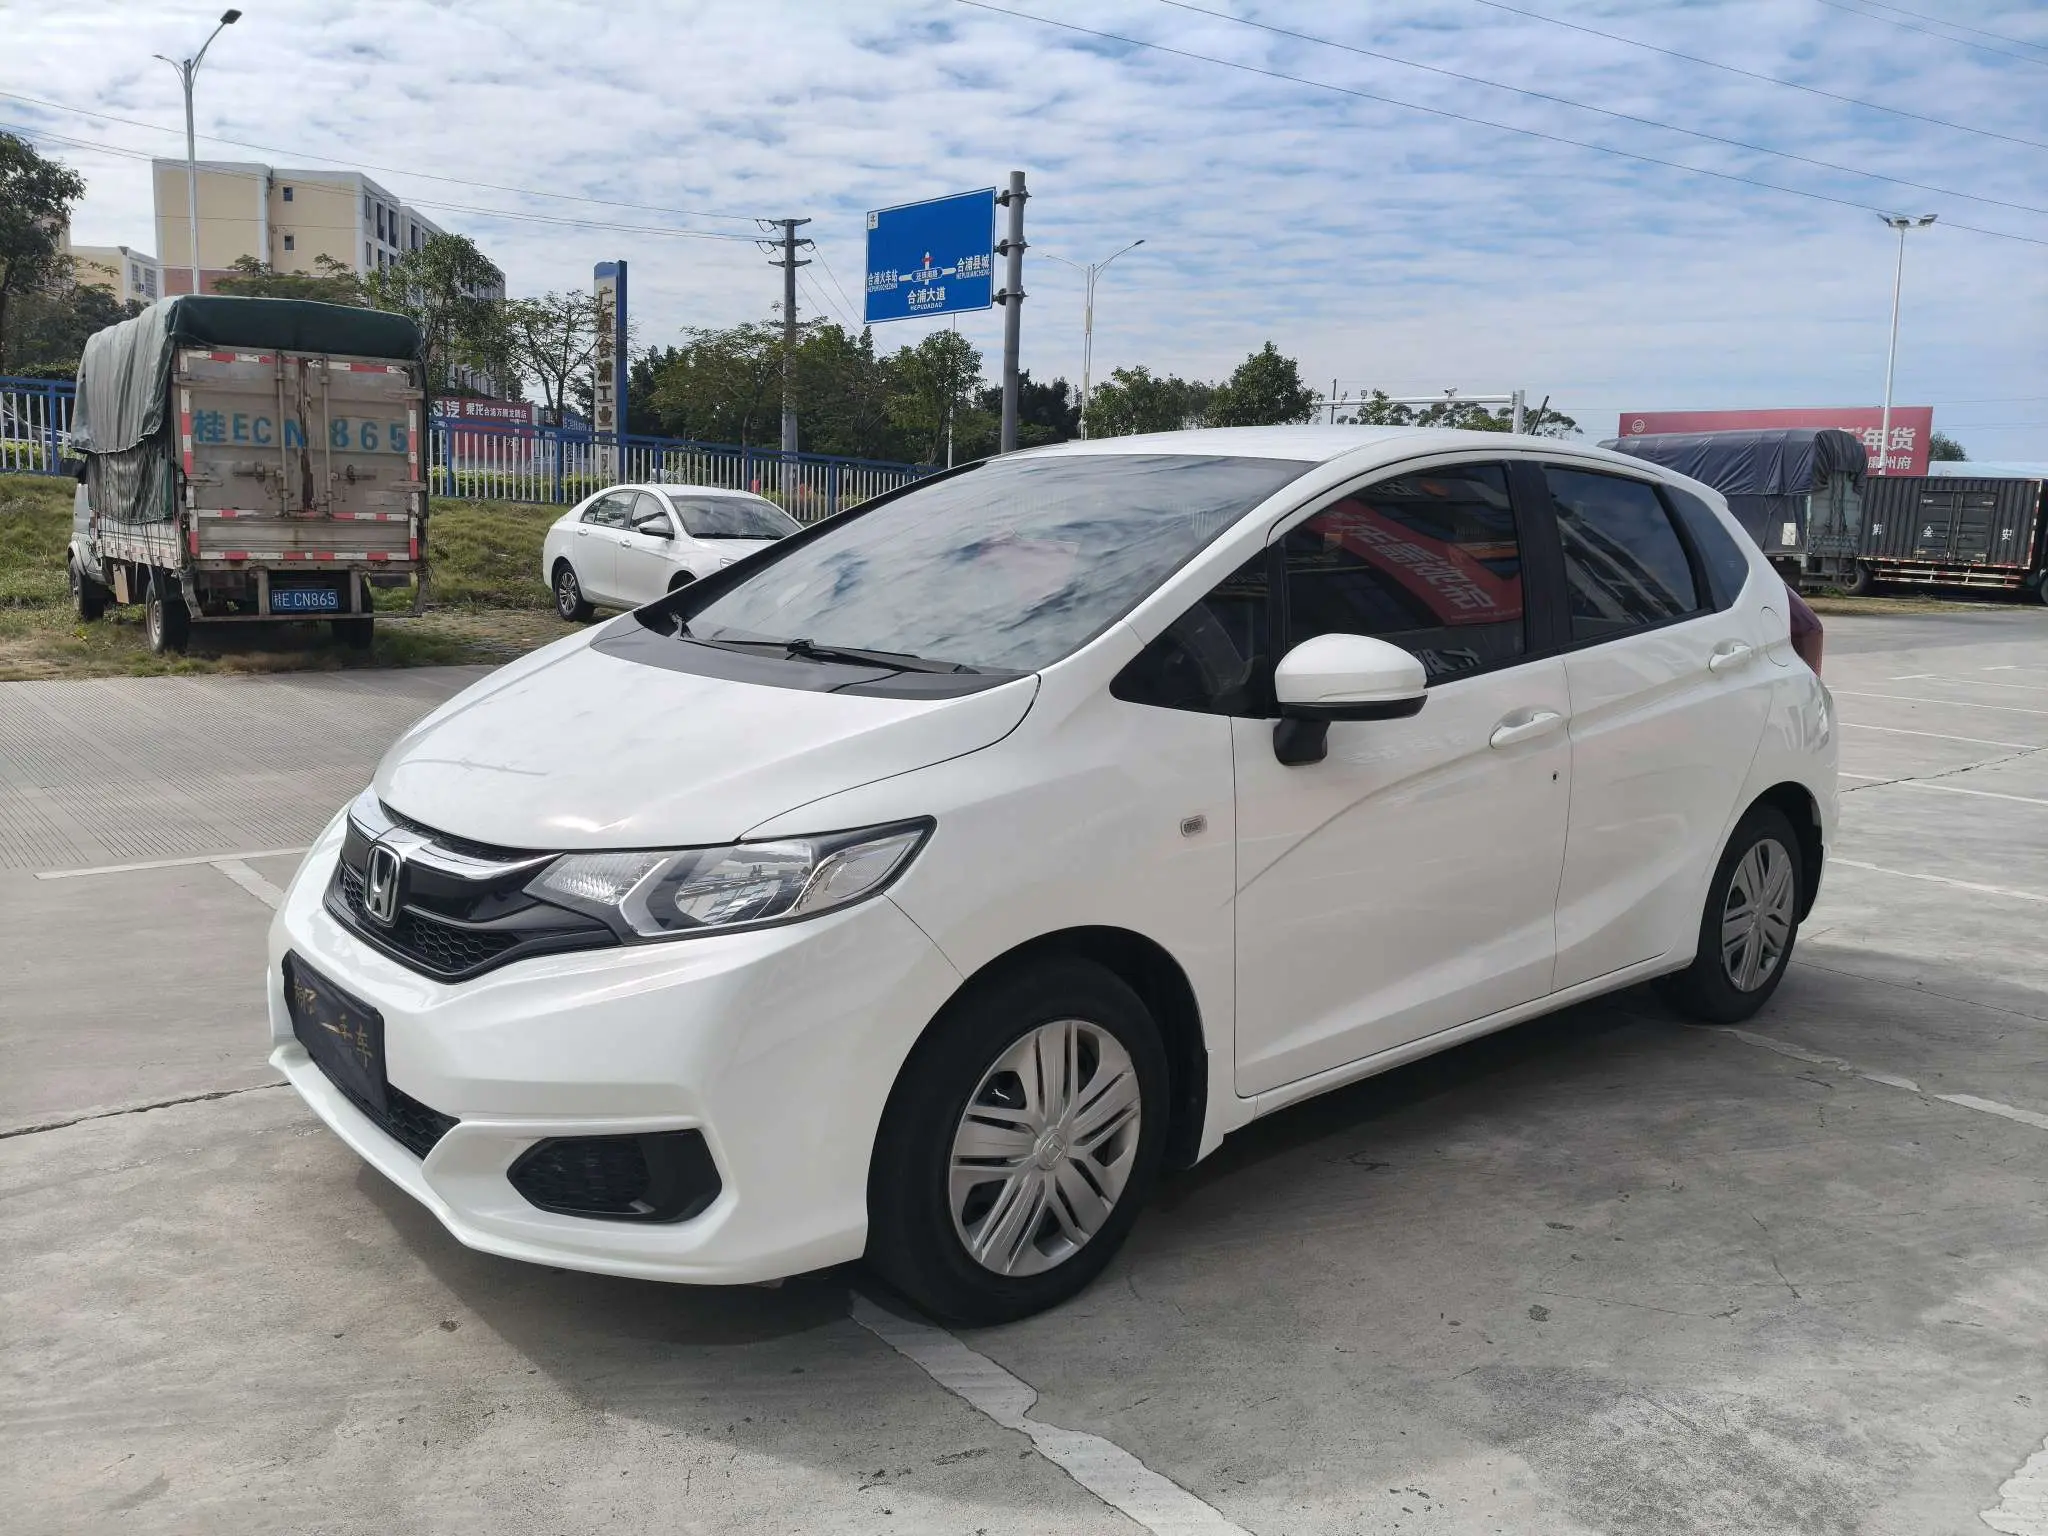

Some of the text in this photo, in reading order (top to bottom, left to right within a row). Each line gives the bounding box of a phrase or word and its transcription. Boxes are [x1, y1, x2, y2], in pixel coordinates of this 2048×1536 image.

[957, 254, 990, 272] 合浦县城
[868, 269, 897, 286] 合浦火车站
[907, 286, 946, 304] 合浦大道
